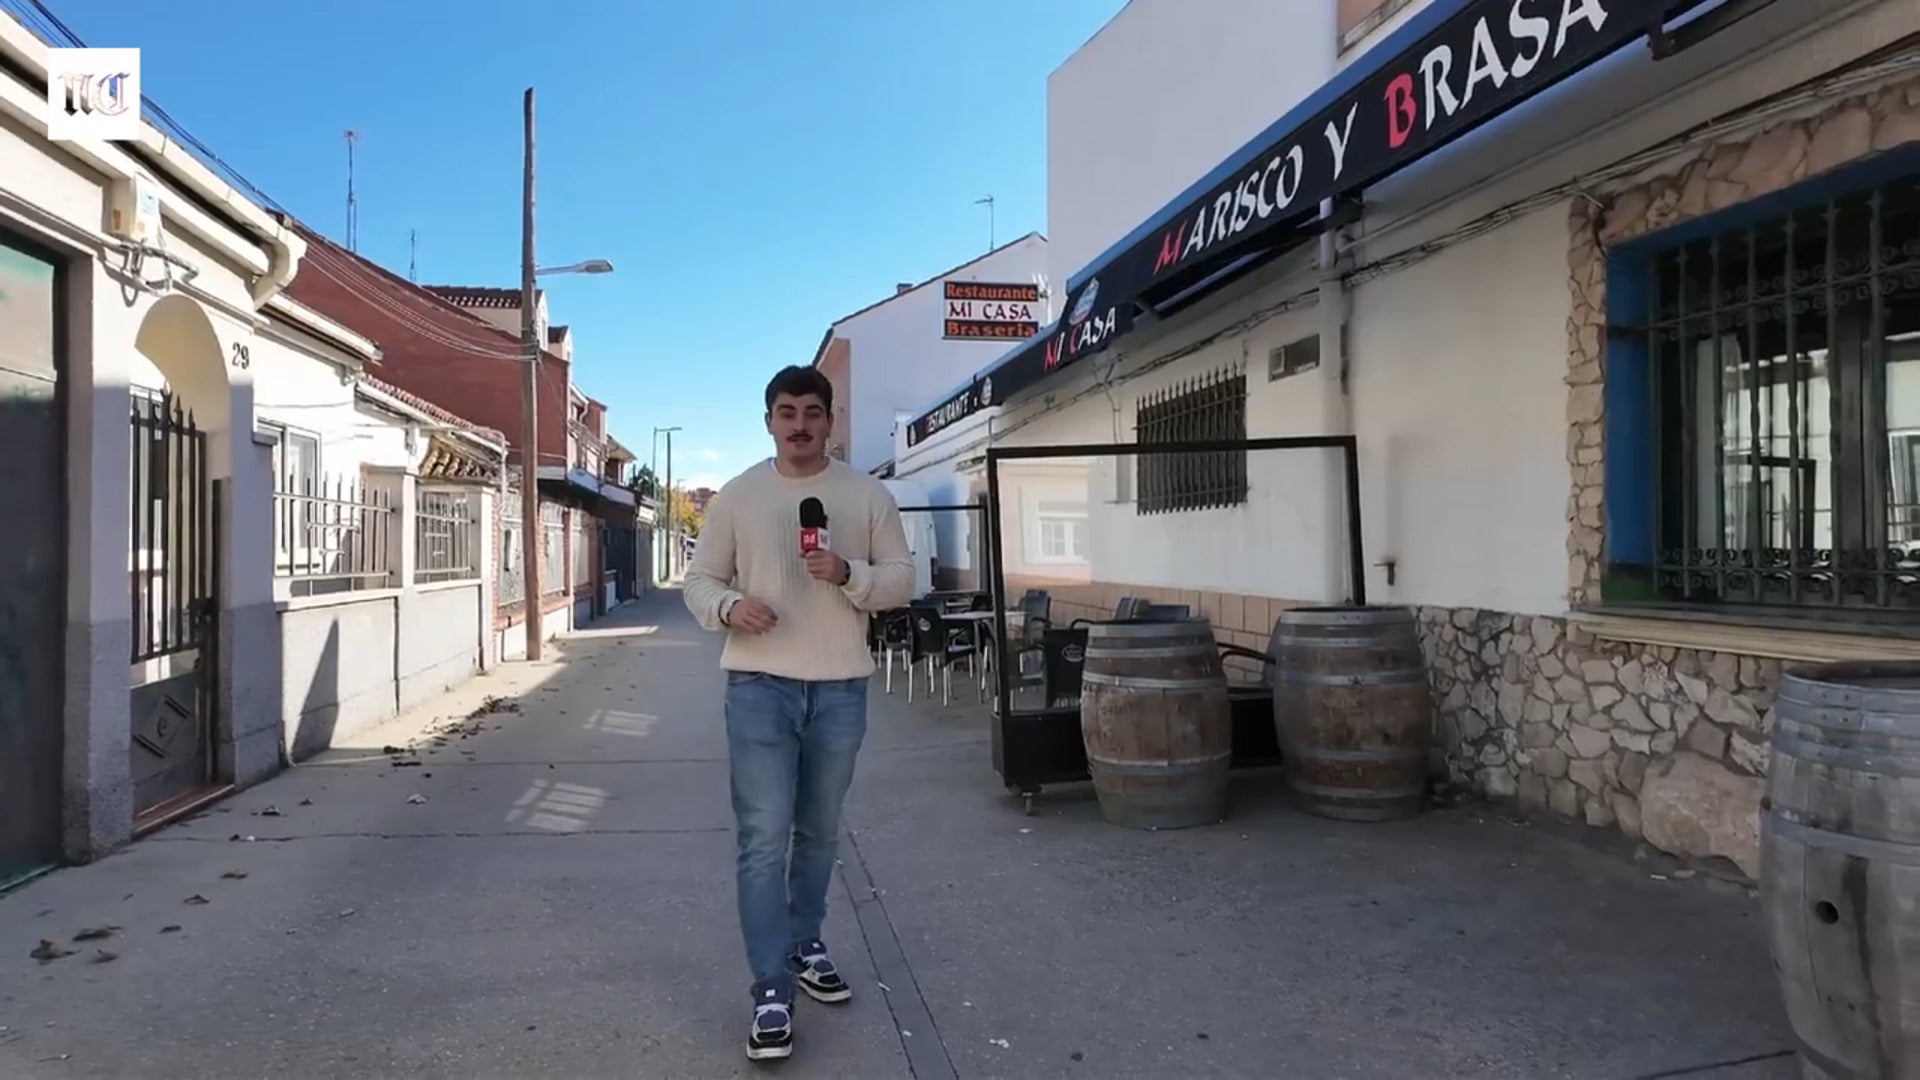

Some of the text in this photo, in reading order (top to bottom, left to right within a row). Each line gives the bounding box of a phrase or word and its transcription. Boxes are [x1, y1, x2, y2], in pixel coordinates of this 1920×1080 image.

[1153, 0, 1609, 276] MARISCO Y BRASA
[946, 283, 1037, 299] Restaurante
[949, 301, 1032, 320] MI CASA
[946, 321, 1036, 338] Braseria
[1044, 306, 1116, 371] MI CASA
[232, 341, 250, 370] 29
